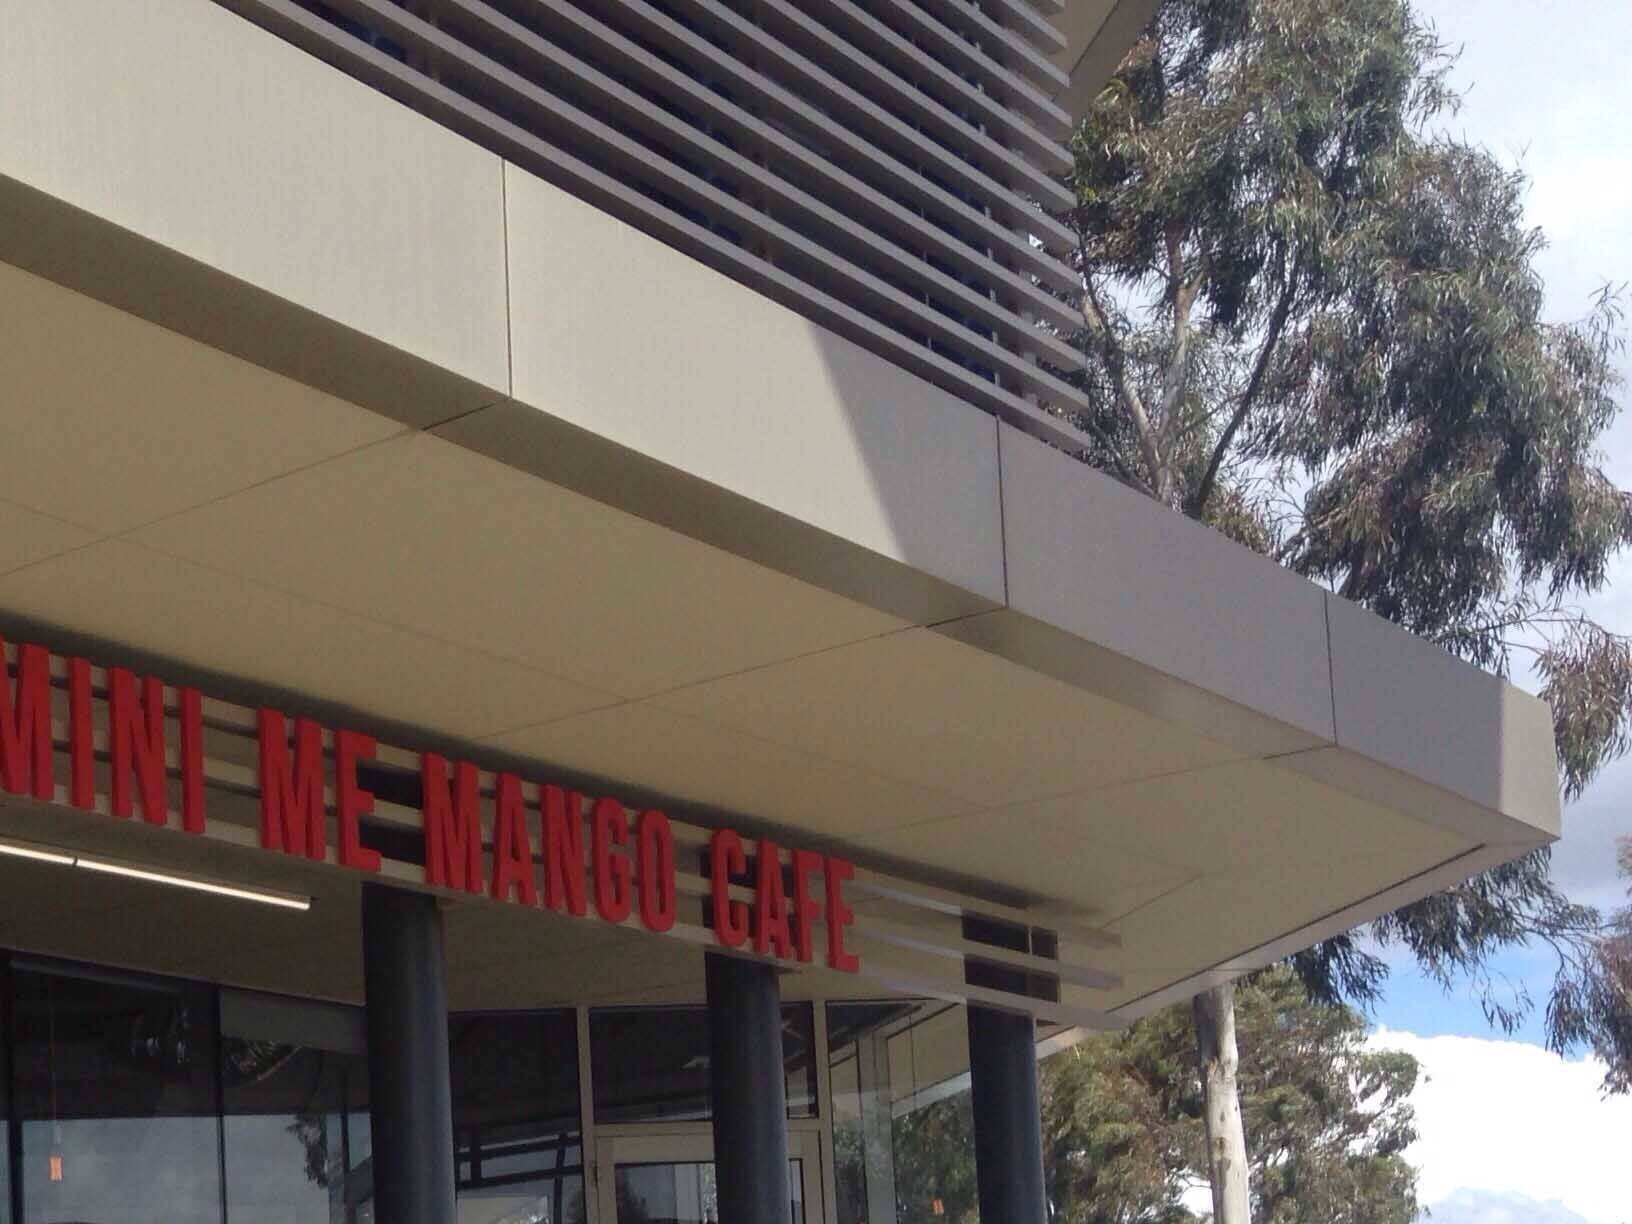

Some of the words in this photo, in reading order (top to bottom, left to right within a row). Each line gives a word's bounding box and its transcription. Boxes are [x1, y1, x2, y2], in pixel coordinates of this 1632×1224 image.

[255, 707, 382, 873] ME
[420, 751, 677, 933] MANGO
[710, 828, 860, 972] CAFE
